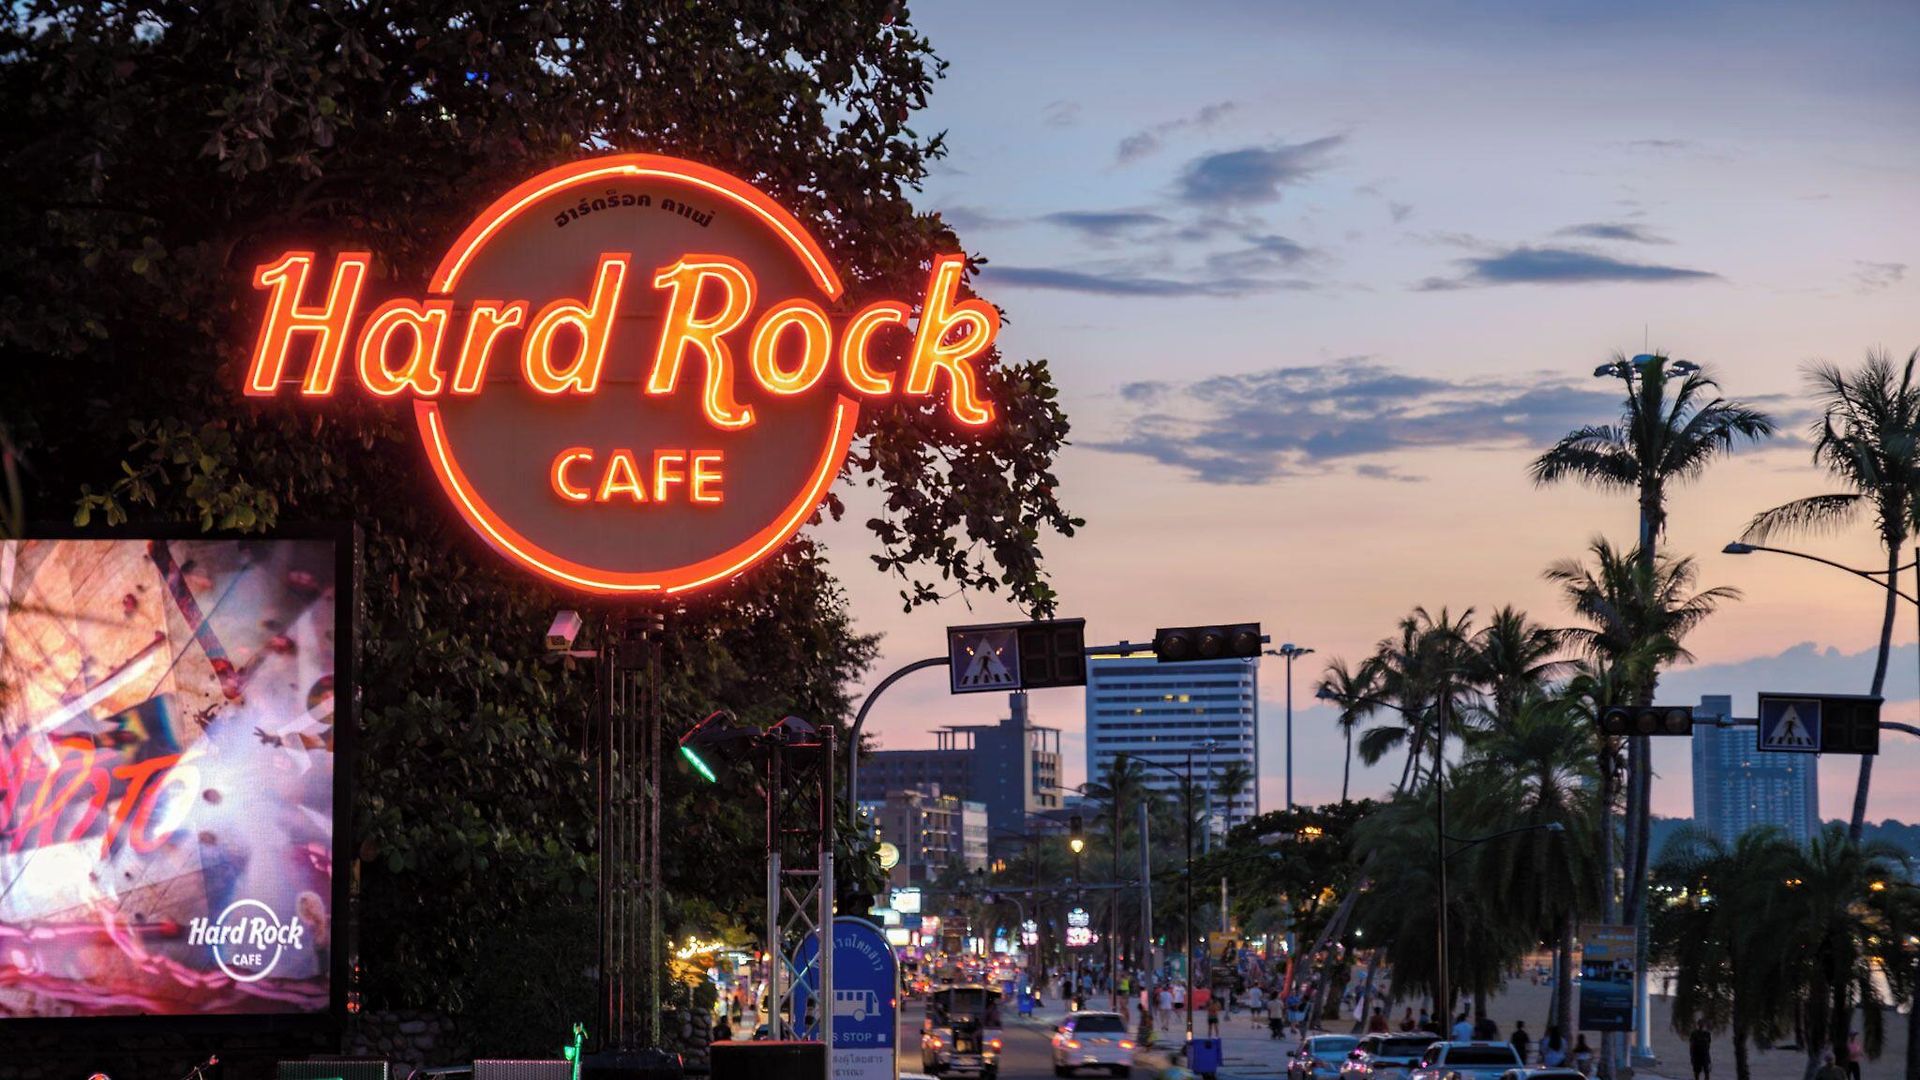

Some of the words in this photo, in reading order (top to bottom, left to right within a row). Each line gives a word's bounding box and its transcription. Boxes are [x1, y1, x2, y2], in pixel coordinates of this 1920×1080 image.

[661, 198, 716, 228] คาเฟ่
[243, 251, 631, 397] Hard
[645, 253, 1000, 431] Rock
[550, 447, 724, 504] CAFE
[188, 916, 248, 946] Hard
[248, 916, 304, 950] Rock
[232, 953, 263, 966] CAFE
[843, 1032, 872, 1042] STOP
